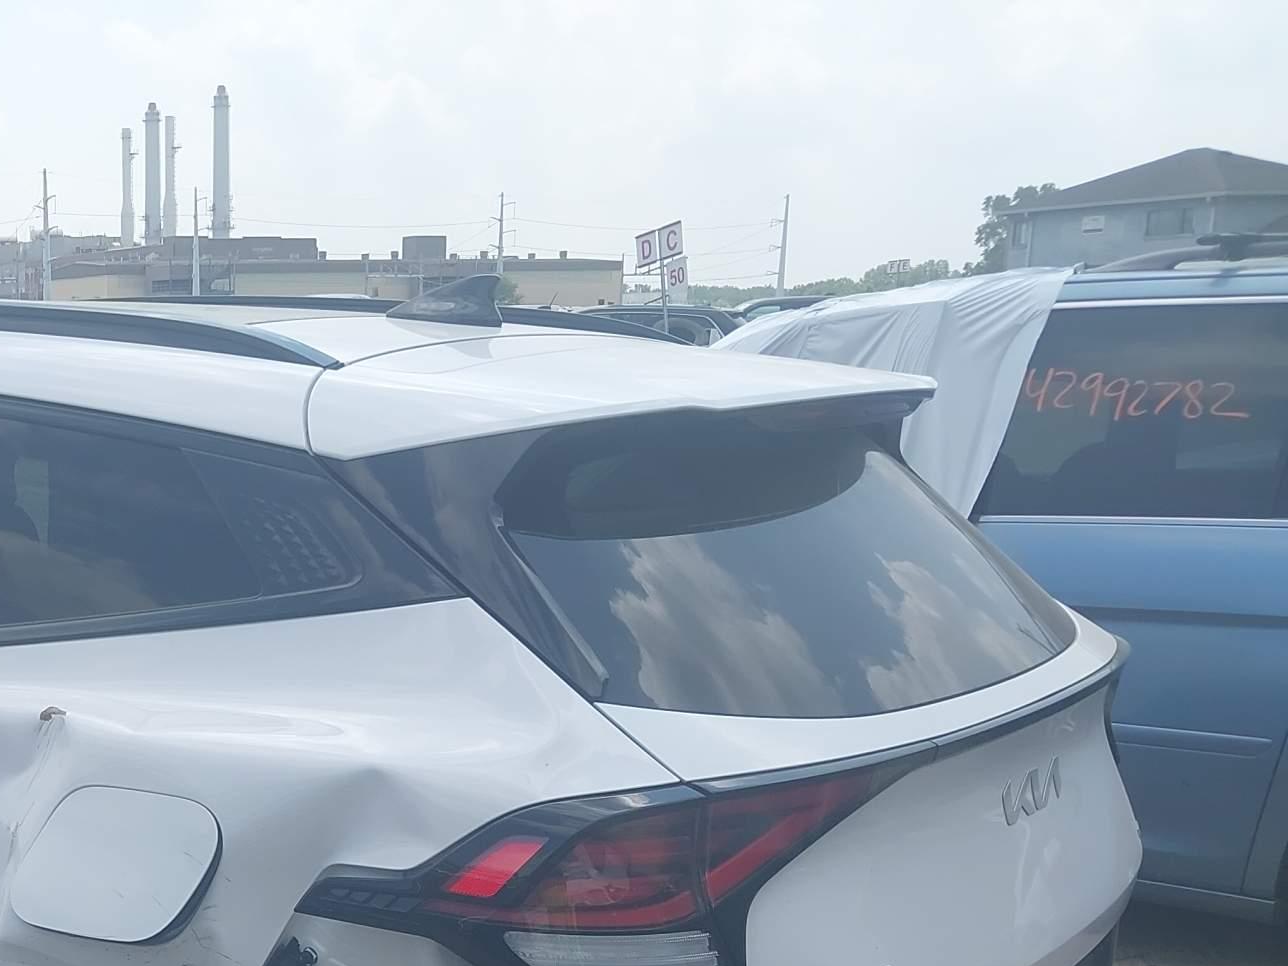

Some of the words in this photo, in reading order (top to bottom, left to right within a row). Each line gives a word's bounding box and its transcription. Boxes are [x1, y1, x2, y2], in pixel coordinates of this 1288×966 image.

[641, 239, 652, 261] D
[666, 229, 678, 251] C
[669, 266, 685, 287] 50
[1025, 367, 1251, 421] 42992782
